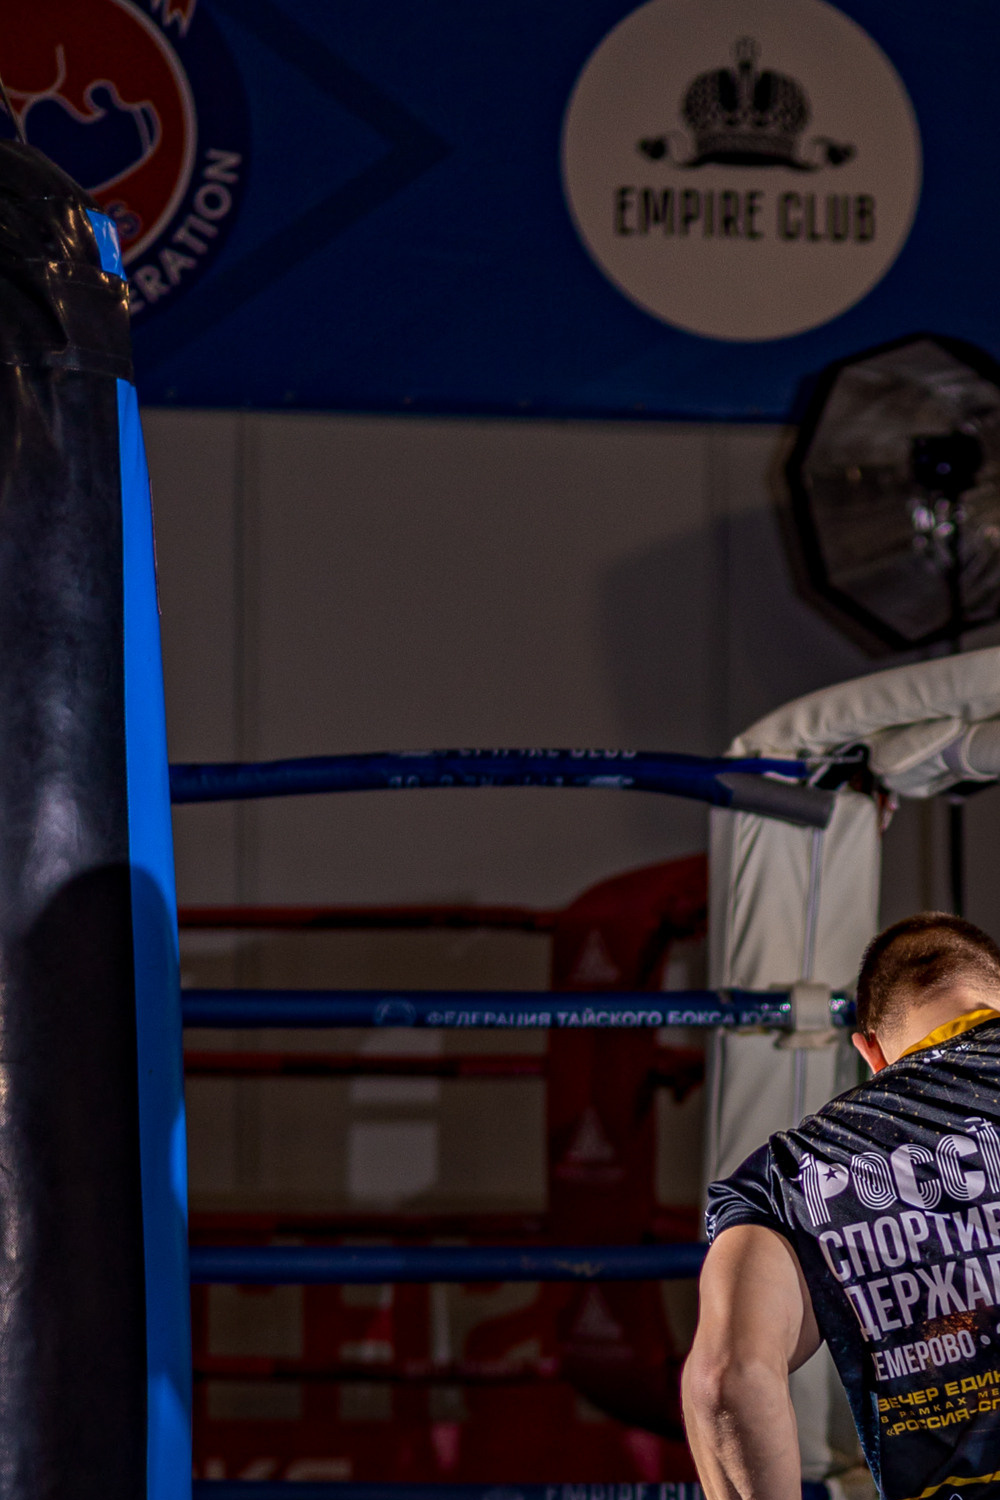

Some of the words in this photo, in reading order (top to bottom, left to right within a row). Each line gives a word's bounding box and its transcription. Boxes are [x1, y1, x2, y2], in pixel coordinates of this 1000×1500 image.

[614, 186, 763, 238] EMPIRE
[778, 192, 876, 241] CLUB
[425, 1010, 551, 1028] ФЕДЕРАЦИЯ
[556, 1007, 663, 1027] ТАЙСКОГО
[666, 1009, 735, 1026] БОКСА
[870, 1329, 976, 1382] ЕМЕРОВО
[878, 1387, 939, 1412] ВЕЧЕР
[880, 1415, 889, 1424] В
[899, 1397, 967, 1418] РАМКАХ
